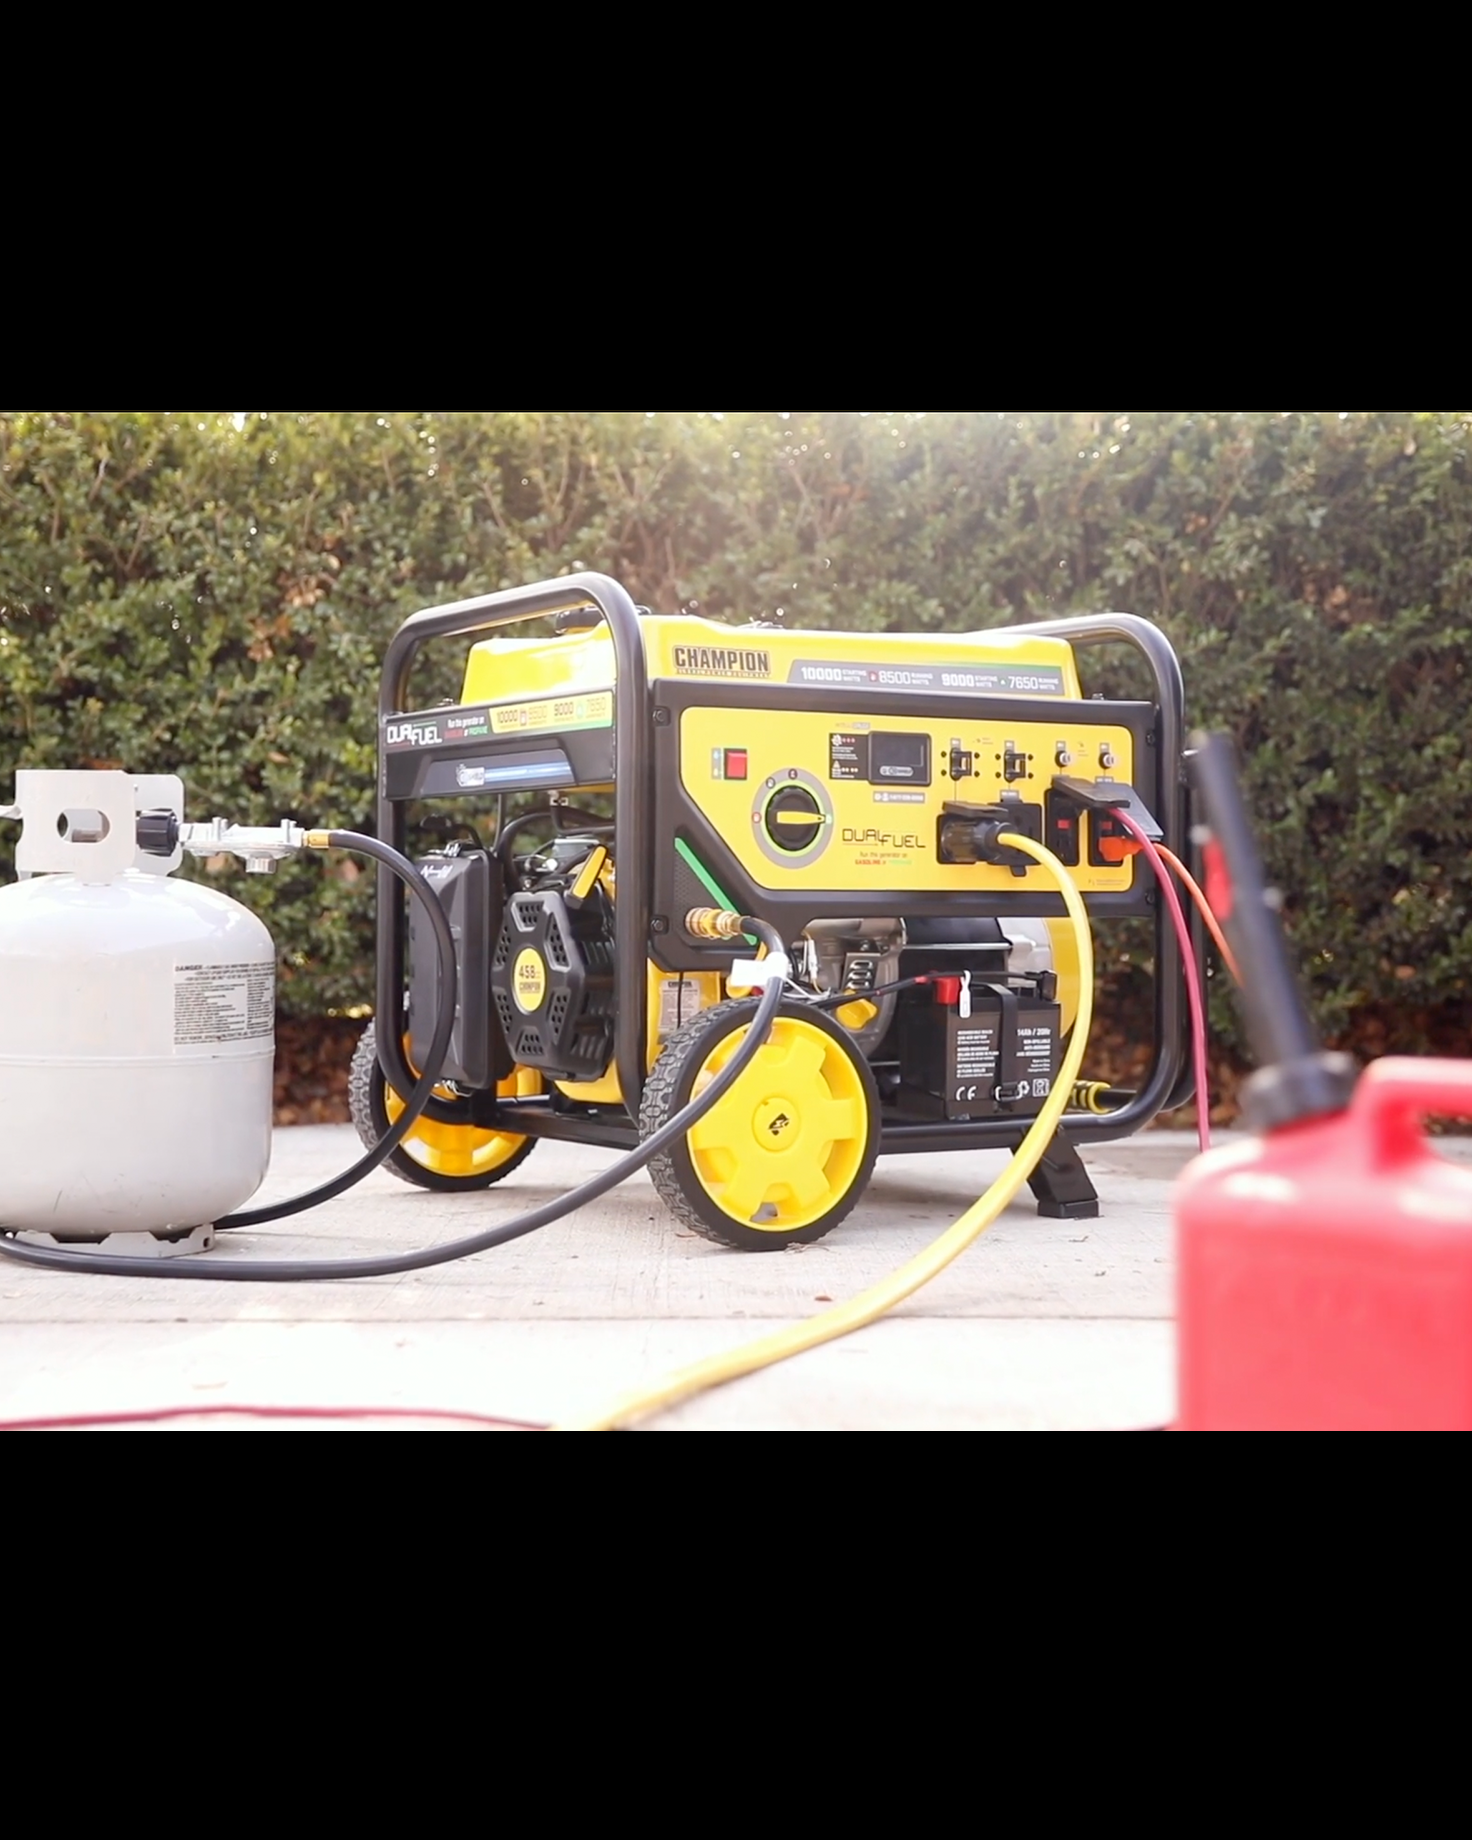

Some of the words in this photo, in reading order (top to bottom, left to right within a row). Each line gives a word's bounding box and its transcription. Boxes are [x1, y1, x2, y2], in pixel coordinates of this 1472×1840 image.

[674, 647, 769, 672] CHAMPION
[801, 666, 841, 681] 10000
[878, 670, 911, 685] 8500
[941, 673, 975, 687] 9000
[1008, 676, 1038, 690] 7650
[879, 834, 926, 849] FUEL
